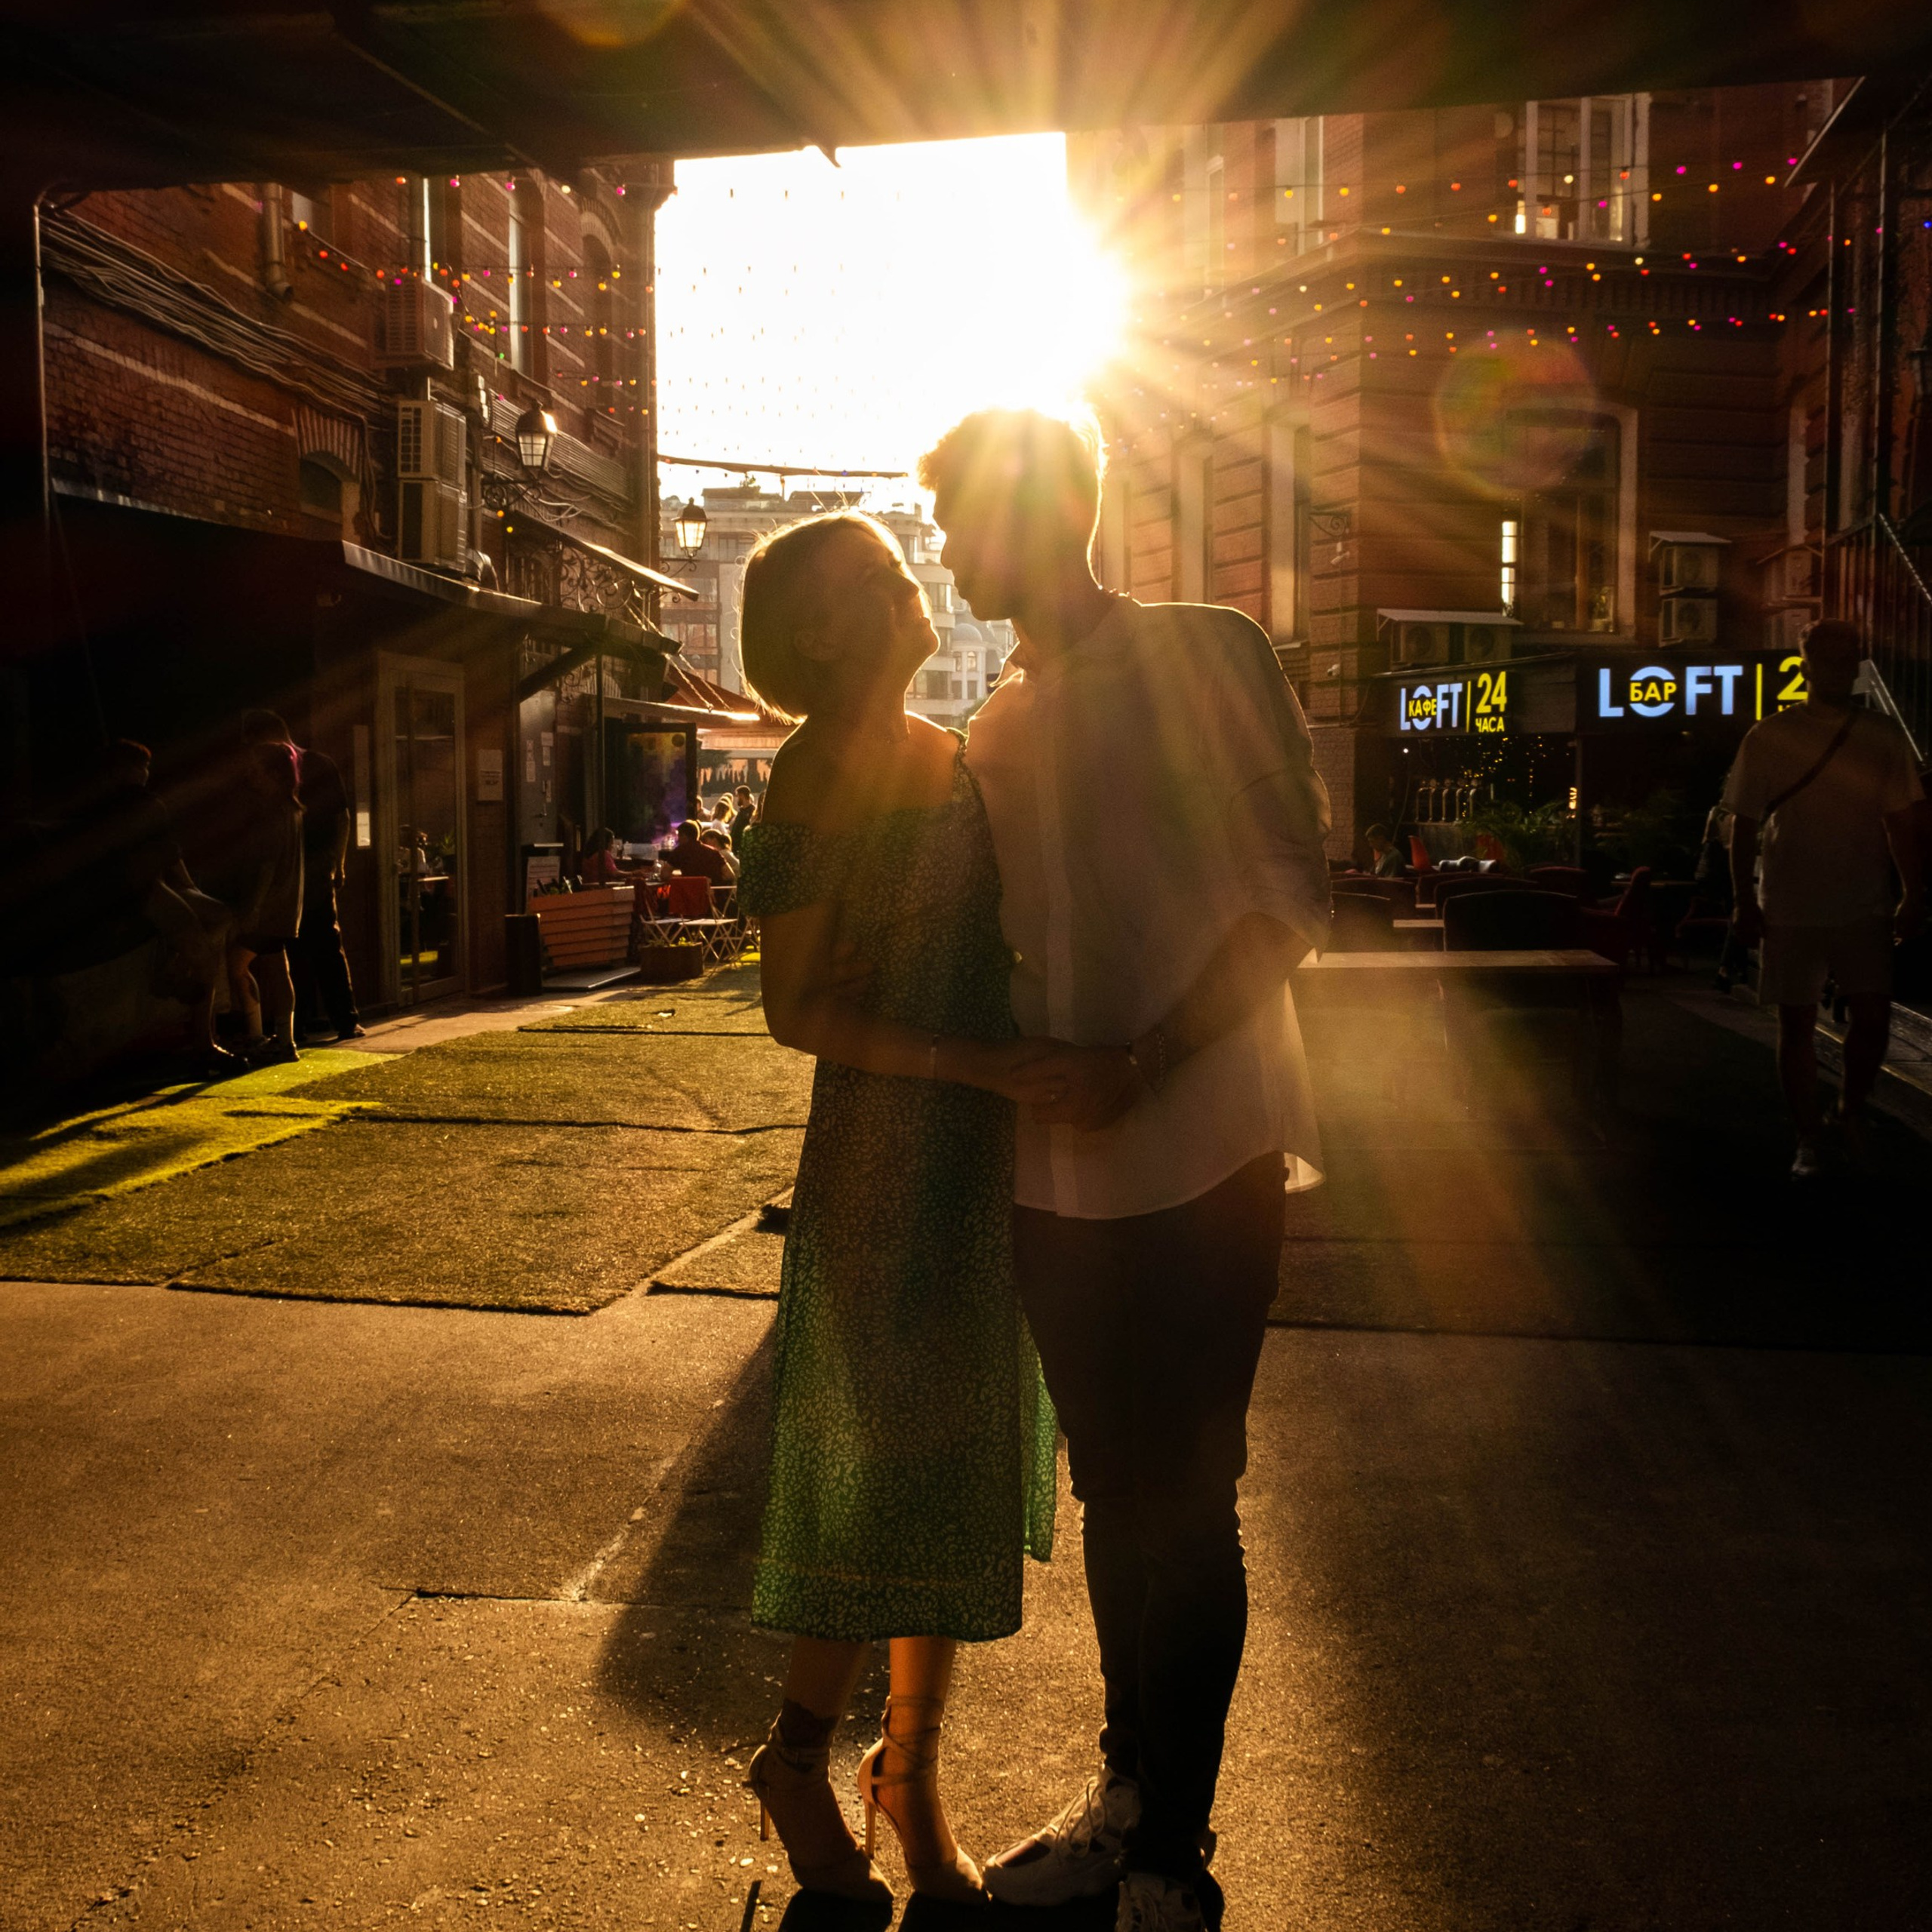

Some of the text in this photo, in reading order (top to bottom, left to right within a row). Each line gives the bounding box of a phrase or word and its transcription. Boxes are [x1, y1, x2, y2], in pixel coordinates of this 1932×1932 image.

[1400, 671, 1507, 731] LOFT 24
[1598, 665, 1743, 717] LOFT
[1629, 681, 1677, 702] БАР
[1408, 698, 1437, 717] КАФЕ
[1475, 716, 1505, 733] ЧАСА
